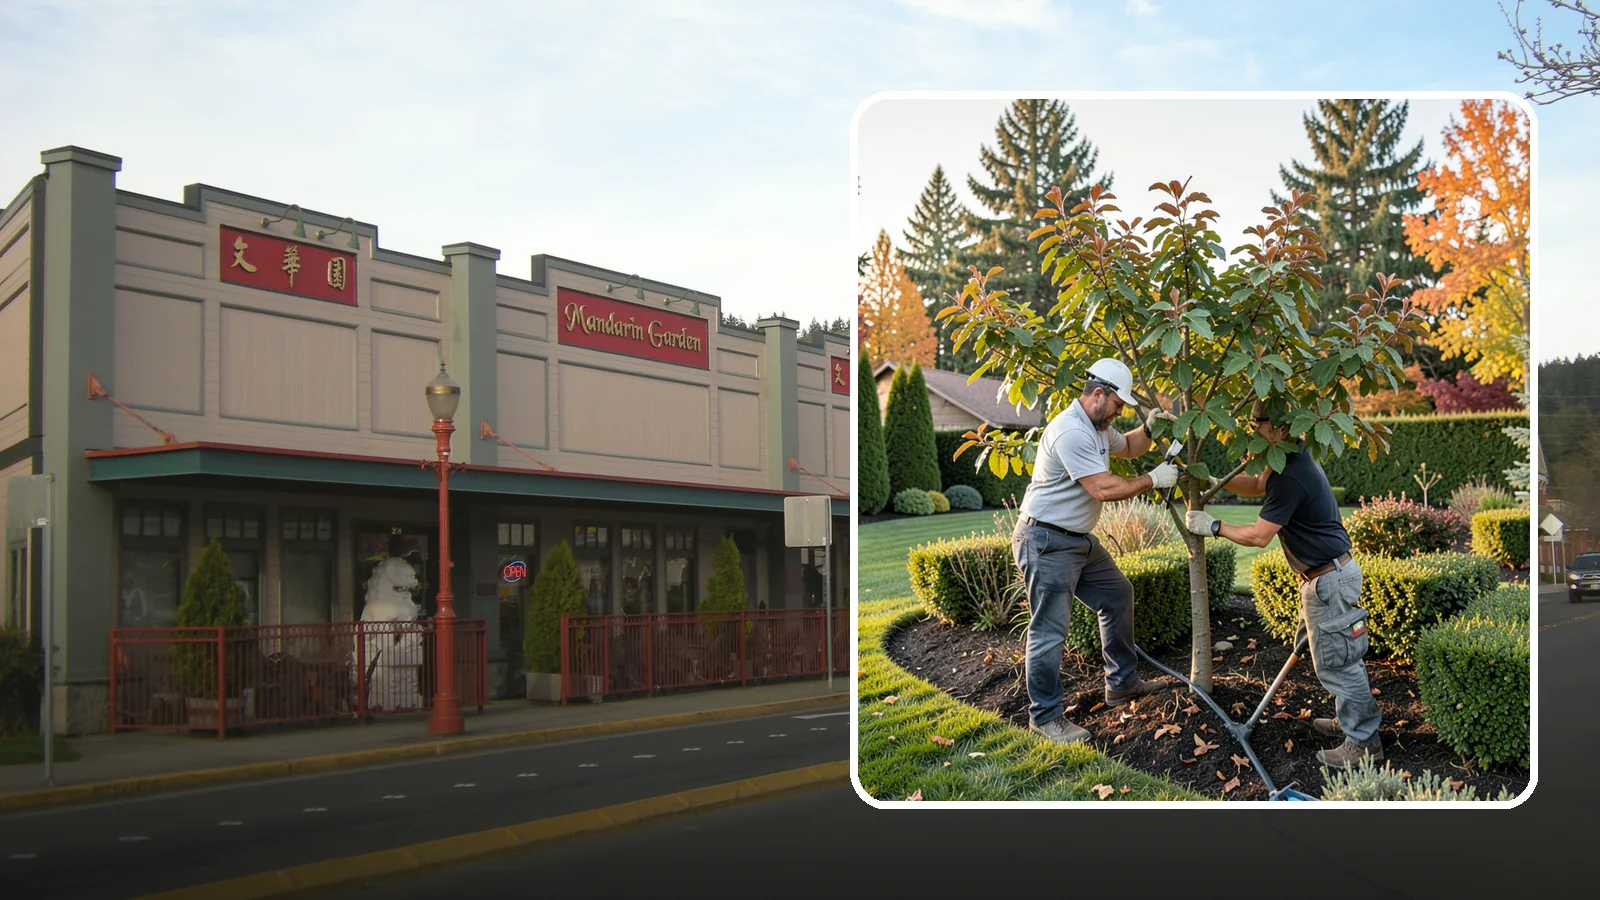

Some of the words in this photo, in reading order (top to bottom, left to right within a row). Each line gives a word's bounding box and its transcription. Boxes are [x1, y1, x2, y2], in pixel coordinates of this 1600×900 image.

[231, 236, 346, 290] 文華園
[565, 302, 644, 341] Mandarin
[648, 320, 702, 352] Garden
[504, 565, 527, 578] OPEN
